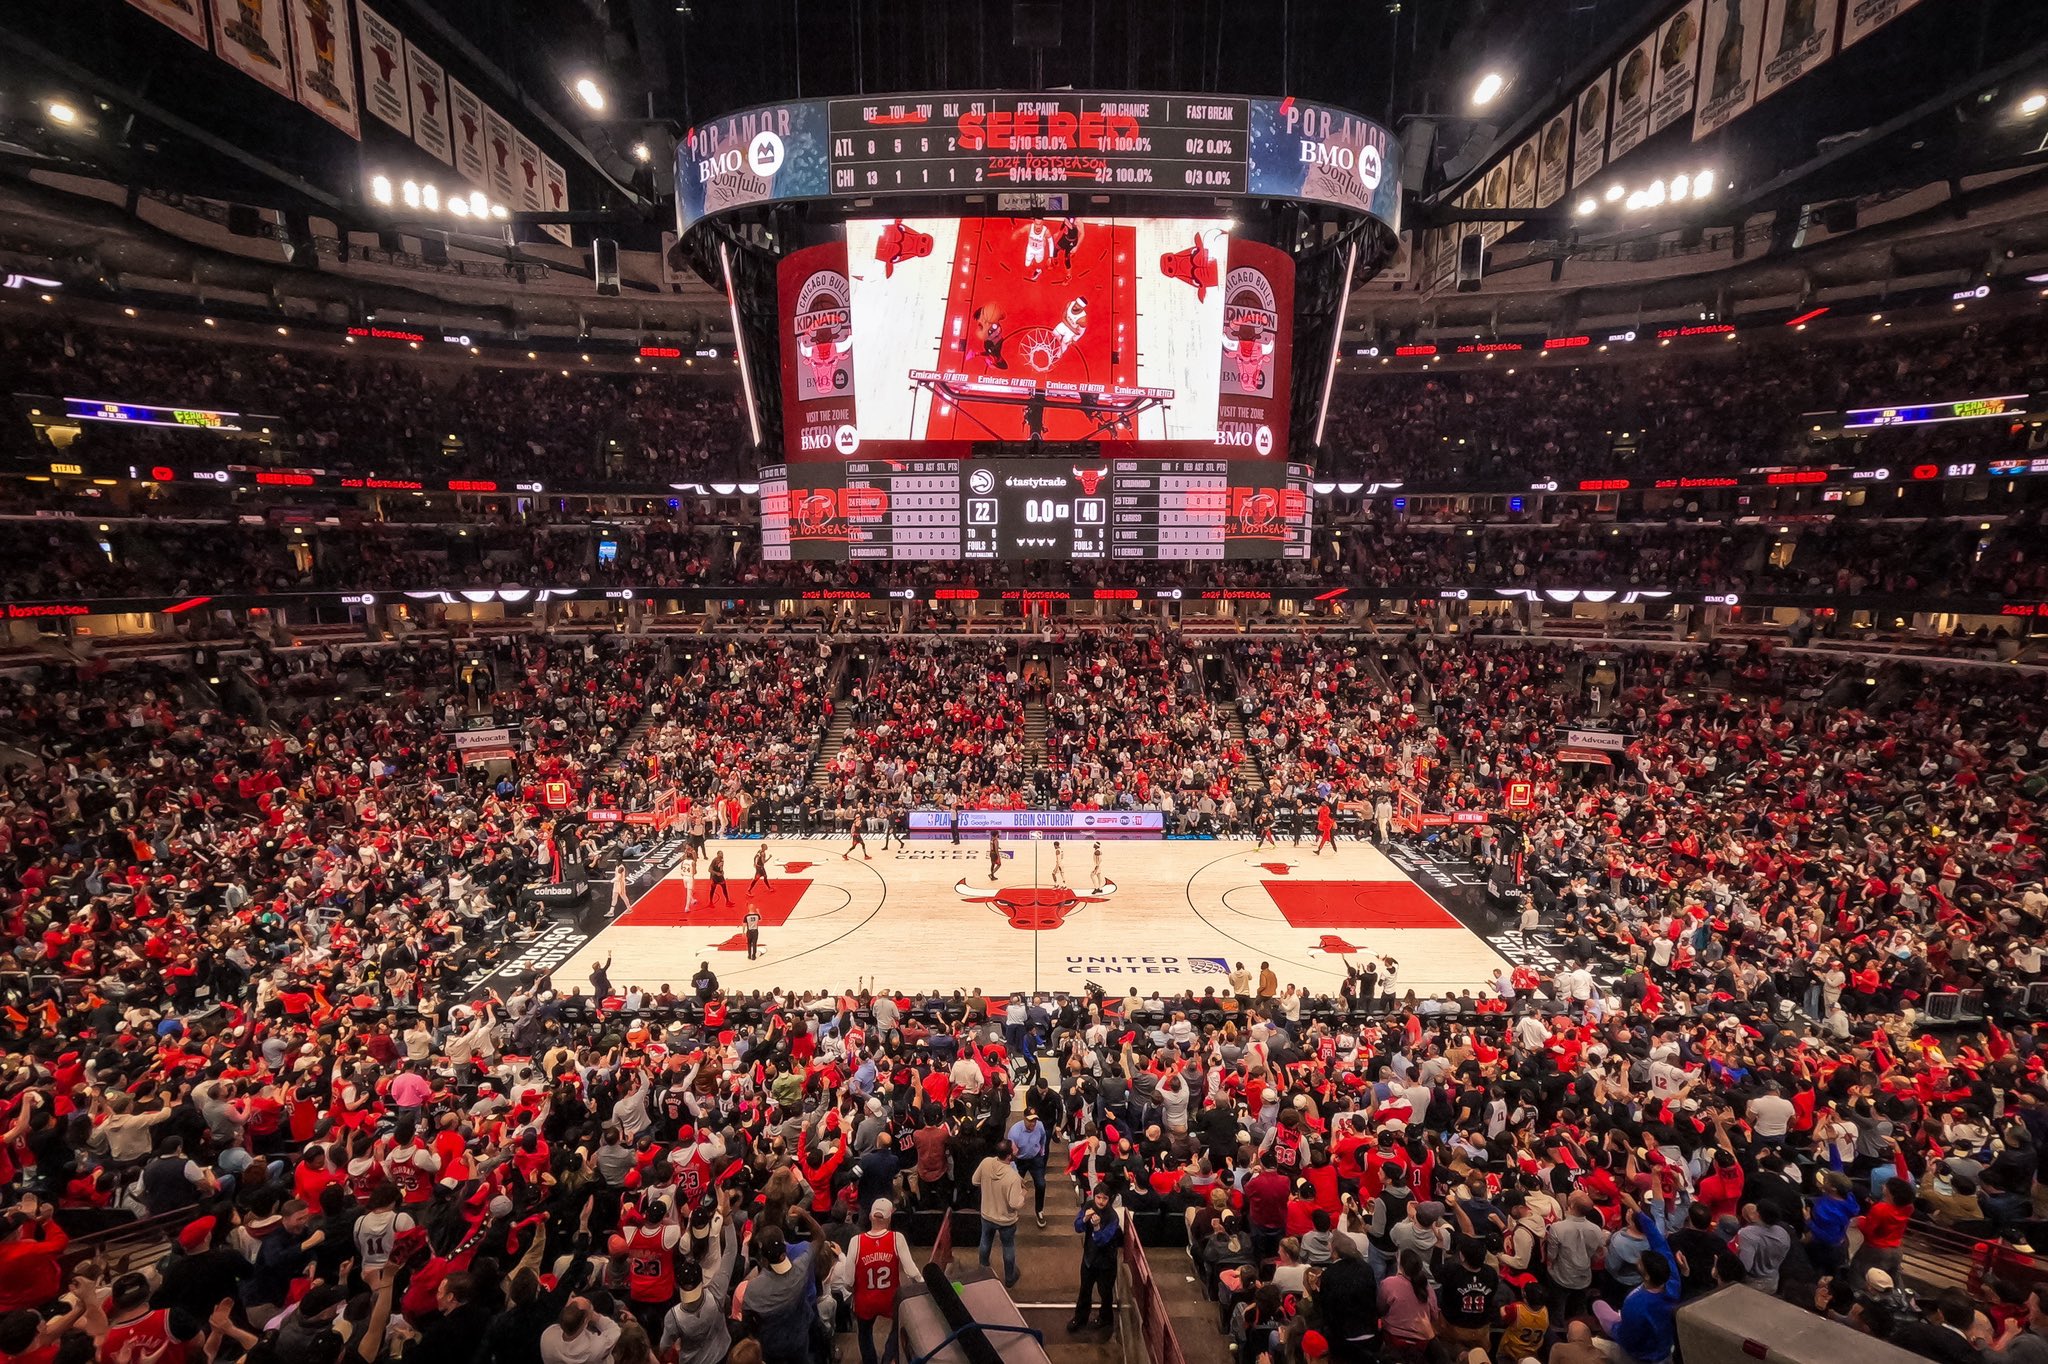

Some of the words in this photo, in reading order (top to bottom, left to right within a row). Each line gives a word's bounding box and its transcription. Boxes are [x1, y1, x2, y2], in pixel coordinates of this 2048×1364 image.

[863, 106, 878, 121] DEF
[889, 105, 905, 119] TOV
[916, 104, 932, 118] TOV
[943, 103, 959, 117] BLK
[971, 102, 986, 116] STL
[1017, 102, 1059, 116] PTS-PAINT
[1100, 103, 1114, 117] 2ND
[1117, 103, 1149, 118] CHANCE
[1186, 105, 1206, 120] FAST
[1208, 106, 1233, 121] BREAK
[691, 125, 719, 162] POR
[728, 109, 791, 146] AMOR
[957, 111, 1040, 149] SEE
[1047, 111, 1139, 149] RED
[1286, 106, 1332, 139] POR
[1341, 116, 1386, 159] AMOR
[835, 138, 854, 157] ATL
[868, 140, 875, 154] 8
[894, 138, 902, 153] 5
[921, 137, 928, 152] 5
[948, 137, 955, 151] 2
[975, 136, 983, 150] 0
[1009, 136, 1031, 152] 5/10
[1035, 136, 1067, 150] 50.0%
[1098, 136, 1111, 152] 1/1
[1115, 137, 1151, 152] 100.0%
[1186, 138, 1203, 153] 0/2
[1207, 139, 1231, 154] 0.0%
[988, 156, 1020, 168] 2024
[1299, 140, 1354, 170] BMO
[699, 149, 742, 183] BMO
[836, 169, 854, 188] CHI
[866, 171, 878, 185] 13
[895, 170, 901, 184] 1
[922, 169, 928, 183] 1
[949, 168, 955, 182] 1
[975, 167, 983, 181] 2
[1095, 168, 1112, 183] 2/2
[1116, 168, 1152, 183] 100.0%
[1185, 170, 1202, 185] 0/3
[1206, 170, 1231, 185] 0.0%
[799, 274, 827, 309] CHICAGO
[1255, 275, 1273, 307] BULLS
[796, 309, 850, 331] KIDNATIO
[1566, 336, 1590, 347] RED
[640, 347, 659, 356] SEE
[660, 348, 681, 357] RED
[1396, 346, 1415, 356] SEE
[1415, 345, 1437, 355] RED
[910, 371, 941, 380] Emirates
[978, 376, 1009, 385] Emirates
[1046, 381, 1077, 390] Emirates
[1114, 386, 1146, 395] Emirates
[806, 411, 818, 423] VISIT
[820, 409, 831, 421] THE
[832, 408, 849, 420] ZONE
[1219, 406, 1236, 418] VISIT
[1238, 407, 1249, 419] THE
[1250, 408, 1264, 420] ZONE
[801, 434, 831, 450] BMO
[1214, 430, 1253, 446] BMO
[50, 463, 82, 474] STEALS
[849, 464, 869, 472] ATLANTA
[925, 463, 935, 471] AST
[937, 463, 946, 471] STL
[947, 462, 958, 470] PTS
[1195, 463, 1204, 471] AST
[1206, 463, 1214, 471] STL
[1216, 463, 1226, 471] PTS
[1013, 477, 1067, 489] tastytrade
[1603, 479, 1629, 490] RED
[975, 502, 990, 521] 22
[1026, 499, 1054, 522] 0.0
[1082, 502, 1097, 521] 40
[967, 529, 976, 538] TO
[1074, 529, 1082, 538] TO
[1099, 528, 1104, 538] 5
[967, 541, 986, 550] FOULS
[992, 541, 997, 550] 3
[1074, 541, 1093, 550] FOULS
[1099, 541, 1104, 550] 3
[802, 590, 821, 598] 2024
[823, 589, 870, 599] POSTSEASON
[935, 590, 955, 599] SEE
[956, 590, 979, 599] RED
[1001, 590, 1020, 599] 2024
[1022, 589, 1070, 599] POSTSEASON
[1201, 590, 1220, 599] 2024
[1222, 589, 1271, 599] POSTSEASON
[9, 604, 89, 618] POSTSEASON
[469, 733, 507, 744] Advocate
[1581, 735, 1619, 746] Advocate
[1013, 813, 1034, 826] BEGIN
[1037, 813, 1074, 826] SATURDAY
[1420, 864, 1457, 888] ULTRA
[534, 886, 572, 896] coinbase
[498, 926, 574, 978] CHICAGO
[535, 934, 588, 970] BULLS
[1066, 956, 1178, 964] UNITED
[1067, 966, 1181, 974] CENTER
[1654, 1075, 1668, 1090] 12
[899, 1135, 915, 1150] 11
[1275, 1146, 1297, 1166] 33
[396, 1176, 420, 1192] 23
[678, 1171, 700, 1189] 23
[1413, 1168, 1421, 1186] 1
[367, 1238, 384, 1256] 11
[861, 1251, 893, 1266] DOSUNMU
[633, 1258, 661, 1277] 23
[867, 1266, 891, 1289] 12
